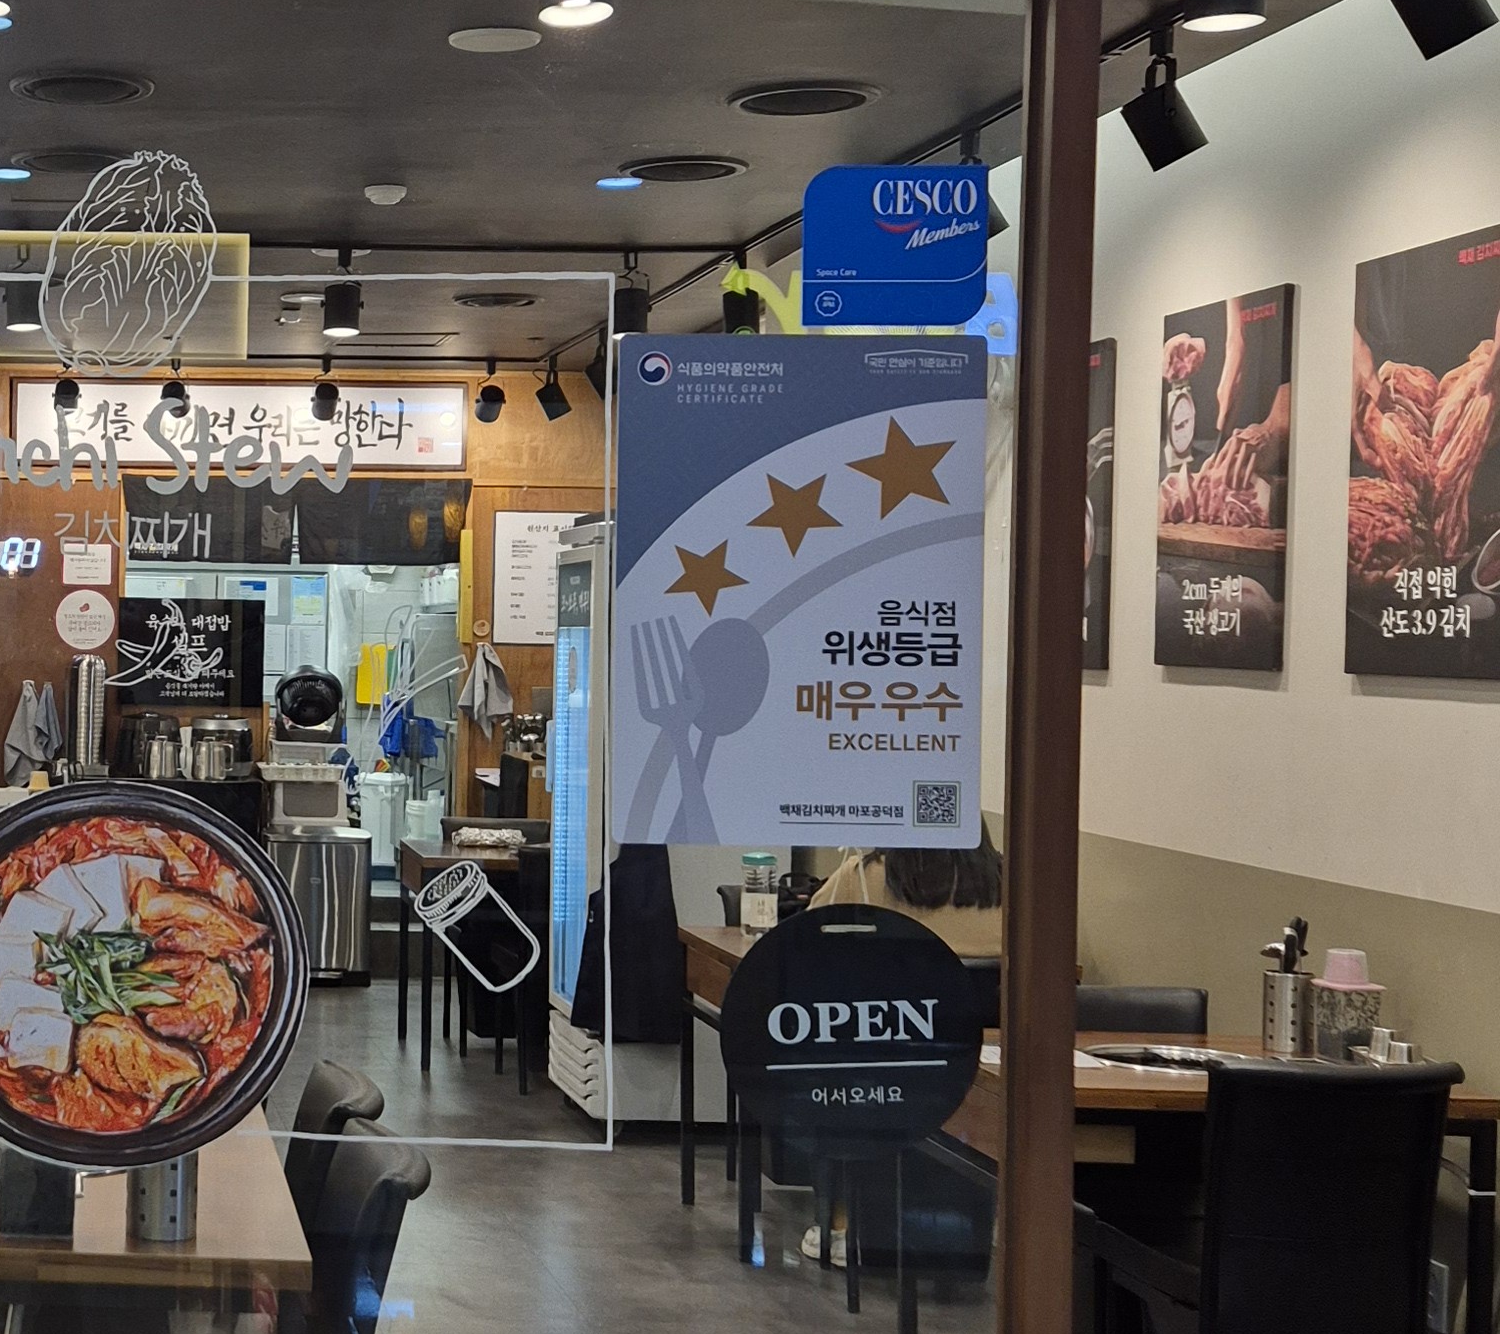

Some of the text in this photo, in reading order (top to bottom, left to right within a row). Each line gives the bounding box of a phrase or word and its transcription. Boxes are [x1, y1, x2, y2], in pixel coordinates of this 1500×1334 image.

[873, 179, 977, 216] CESCO
[904, 218, 981, 250] Members
[816, 268, 857, 277] Space Care
[677, 362, 783, 377] 식품의약품안전처
[677, 383, 784, 394] HYGIENE GRADE
[677, 394, 764, 404] CERTIFICATE
[243, 403, 321, 447] 우리는
[330, 398, 413, 450] 망한다
[146, 398, 353, 496] Stew
[54, 511, 212, 559] 김치찌개
[1182, 575, 1243, 603] 2cm 두께의
[1394, 565, 1457, 601] 직접 익힌
[191, 613, 232, 631] 대접밥
[877, 599, 956, 627] 음식점
[1182, 608, 1241, 637] 국산 생고기
[1380, 605, 1472, 638] 산도 3.9 김치
[822, 630, 963, 667] 위생등급
[796, 680, 963, 722] 매우 우수
[829, 733, 961, 752] EXCELLENT
[779, 804, 904, 818] 백채김치찌개 마포공덕점
[767, 999, 939, 1045] OPEN
[811, 1086, 904, 1106] 어서오세요
